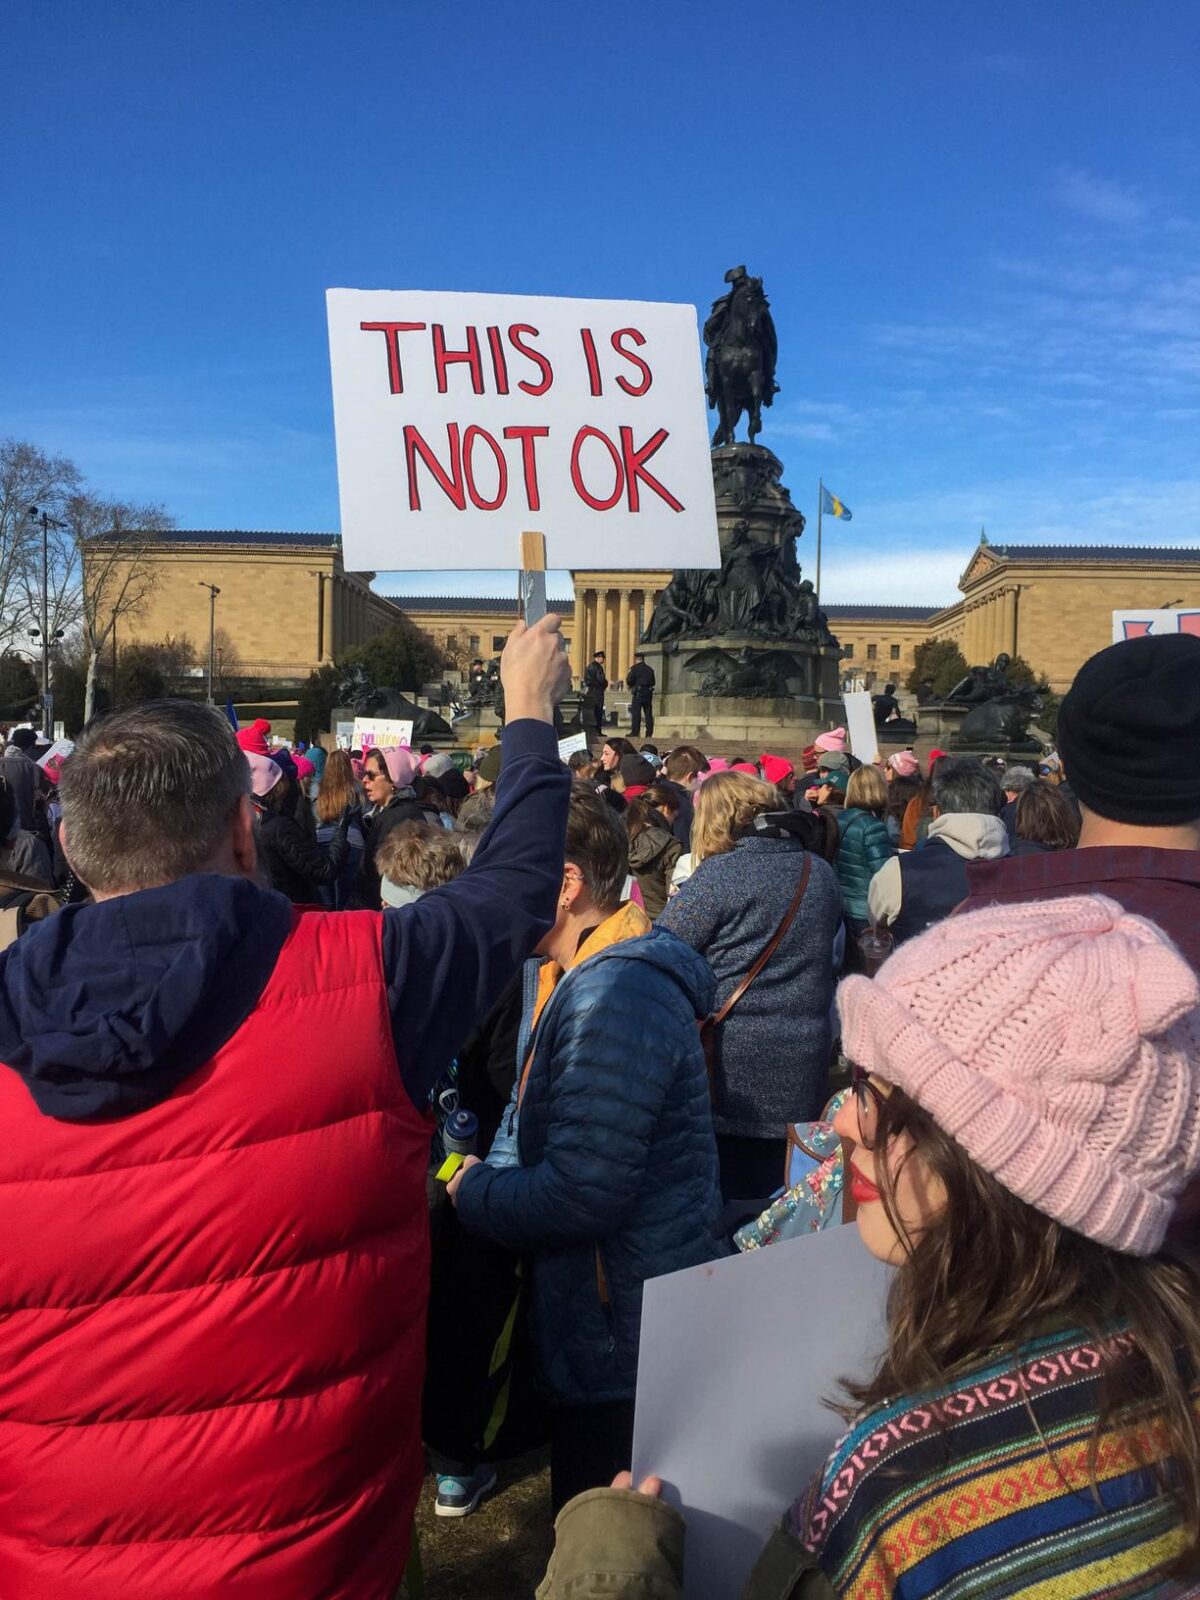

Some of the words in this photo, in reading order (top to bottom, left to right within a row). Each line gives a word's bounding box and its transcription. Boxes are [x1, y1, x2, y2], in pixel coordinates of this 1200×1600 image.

[360, 322, 554, 396] THIS
[581, 328, 653, 396] IS
[403, 422, 549, 511] NOT
[570, 425, 686, 513] OK
